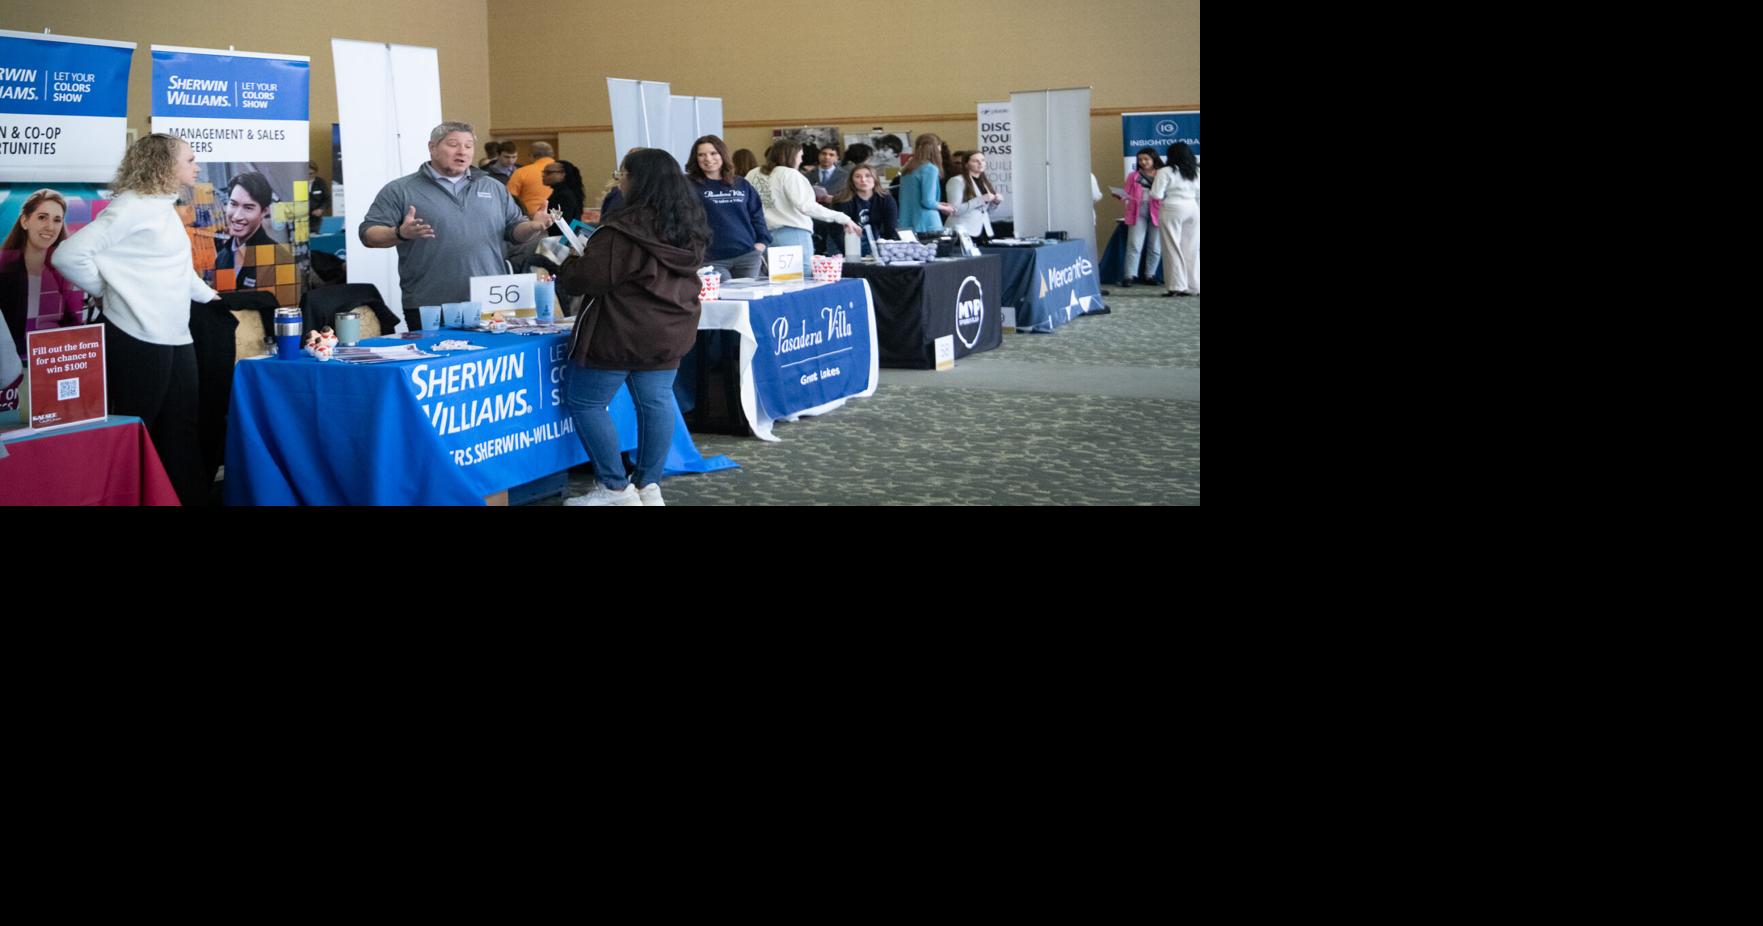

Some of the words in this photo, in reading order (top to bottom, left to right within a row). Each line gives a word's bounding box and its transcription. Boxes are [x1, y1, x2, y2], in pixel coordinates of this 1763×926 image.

[54, 72, 70, 81] LET
[71, 73, 95, 82] YOUR
[168, 75, 228, 92] SHERWIN
[53, 82, 91, 93] COLORS
[242, 82, 255, 91] LET
[255, 83, 278, 92] YOUR
[53, 93, 83, 102] SHOW
[242, 91, 275, 100] COLORS
[242, 100, 268, 109] SHOW
[11, 126, 20, 139] &
[25, 126, 61, 139] CO-OP
[169, 127, 244, 140] MANAGEMENT
[247, 130, 254, 140] &
[257, 129, 285, 140] SALES
[981, 134, 1012, 143] YOU
[0, 142, 56, 155] TUNITIES
[778, 254, 794, 269] 57
[489, 284, 520, 304] 56
[821, 305, 852, 341] Villa
[33, 346, 47, 355] Fill
[48, 346, 62, 354] out
[64, 343, 78, 351] the
[79, 341, 99, 350] form
[36, 357, 49, 365] for
[57, 352, 87, 362] chance
[88, 351, 97, 359] to
[47, 365, 63, 374] win
[64, 361, 88, 372] $100!
[411, 352, 524, 401] SHERWIN
